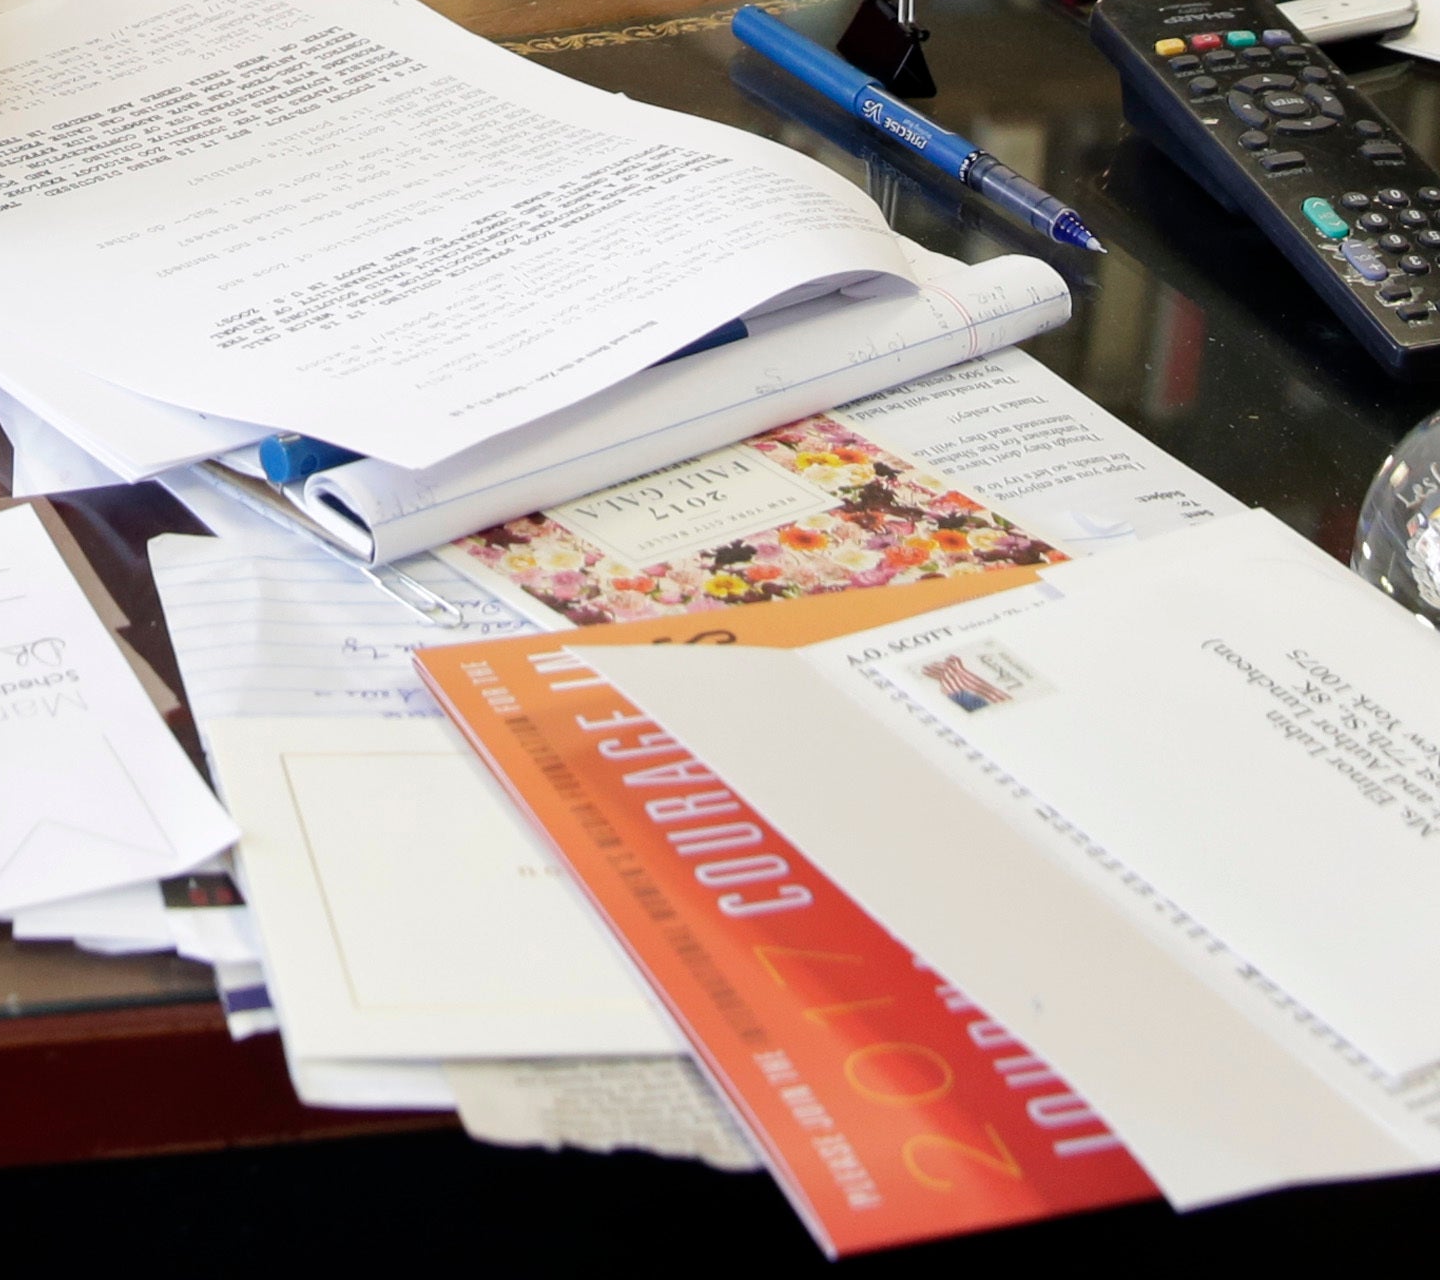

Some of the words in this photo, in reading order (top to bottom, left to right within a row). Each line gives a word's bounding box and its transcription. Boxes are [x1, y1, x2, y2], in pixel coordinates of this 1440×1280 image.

[1163, 11, 1235, 24] SHARP
[862, 100, 883, 125] V5
[1271, 98, 1304, 107] ENTER
[883, 116, 927, 149] PRECISE
[929, 379, 991, 402] Breakfast
[999, 395, 1047, 413] Thanks
[946, 403, 999, 424] Lesley!!
[1012, 413, 1074, 433] interested
[1022, 423, 1088, 446] Fundraiser
[1055, 432, 1102, 449] Though
[927, 448, 977, 468] Shehan
[1102, 459, 1135, 475] hope
[672, 458, 751, 491] FALL
[573, 484, 667, 521] GALA
[770, 495, 797, 509] NEW
[995, 477, 1052, 501] enjoying
[646, 489, 727, 521] 2017
[728, 503, 765, 524] YORK
[637, 526, 688, 552] BALLET
[693, 517, 724, 535] CITY
[846, 647, 888, 668] A.O.
[887, 625, 953, 655] SCOTT
[1200, 638, 1314, 720] Luncheon)
[1286, 648, 1352, 694] 10075
[1291, 681, 1333, 705] 8K
[1351, 693, 1401, 732] York
[1266, 709, 1327, 759] Lubin
[1311, 718, 1389, 773] Author
[1367, 730, 1415, 769] 77th
[1326, 757, 1397, 807] Elinor
[1382, 773, 1434, 804] and
[572, 705, 813, 920] COURAGE
[1402, 807, 1440, 838] Ms.
[754, 942, 1022, 1196] 2017
[810, 1132, 882, 1211] PLEASE
